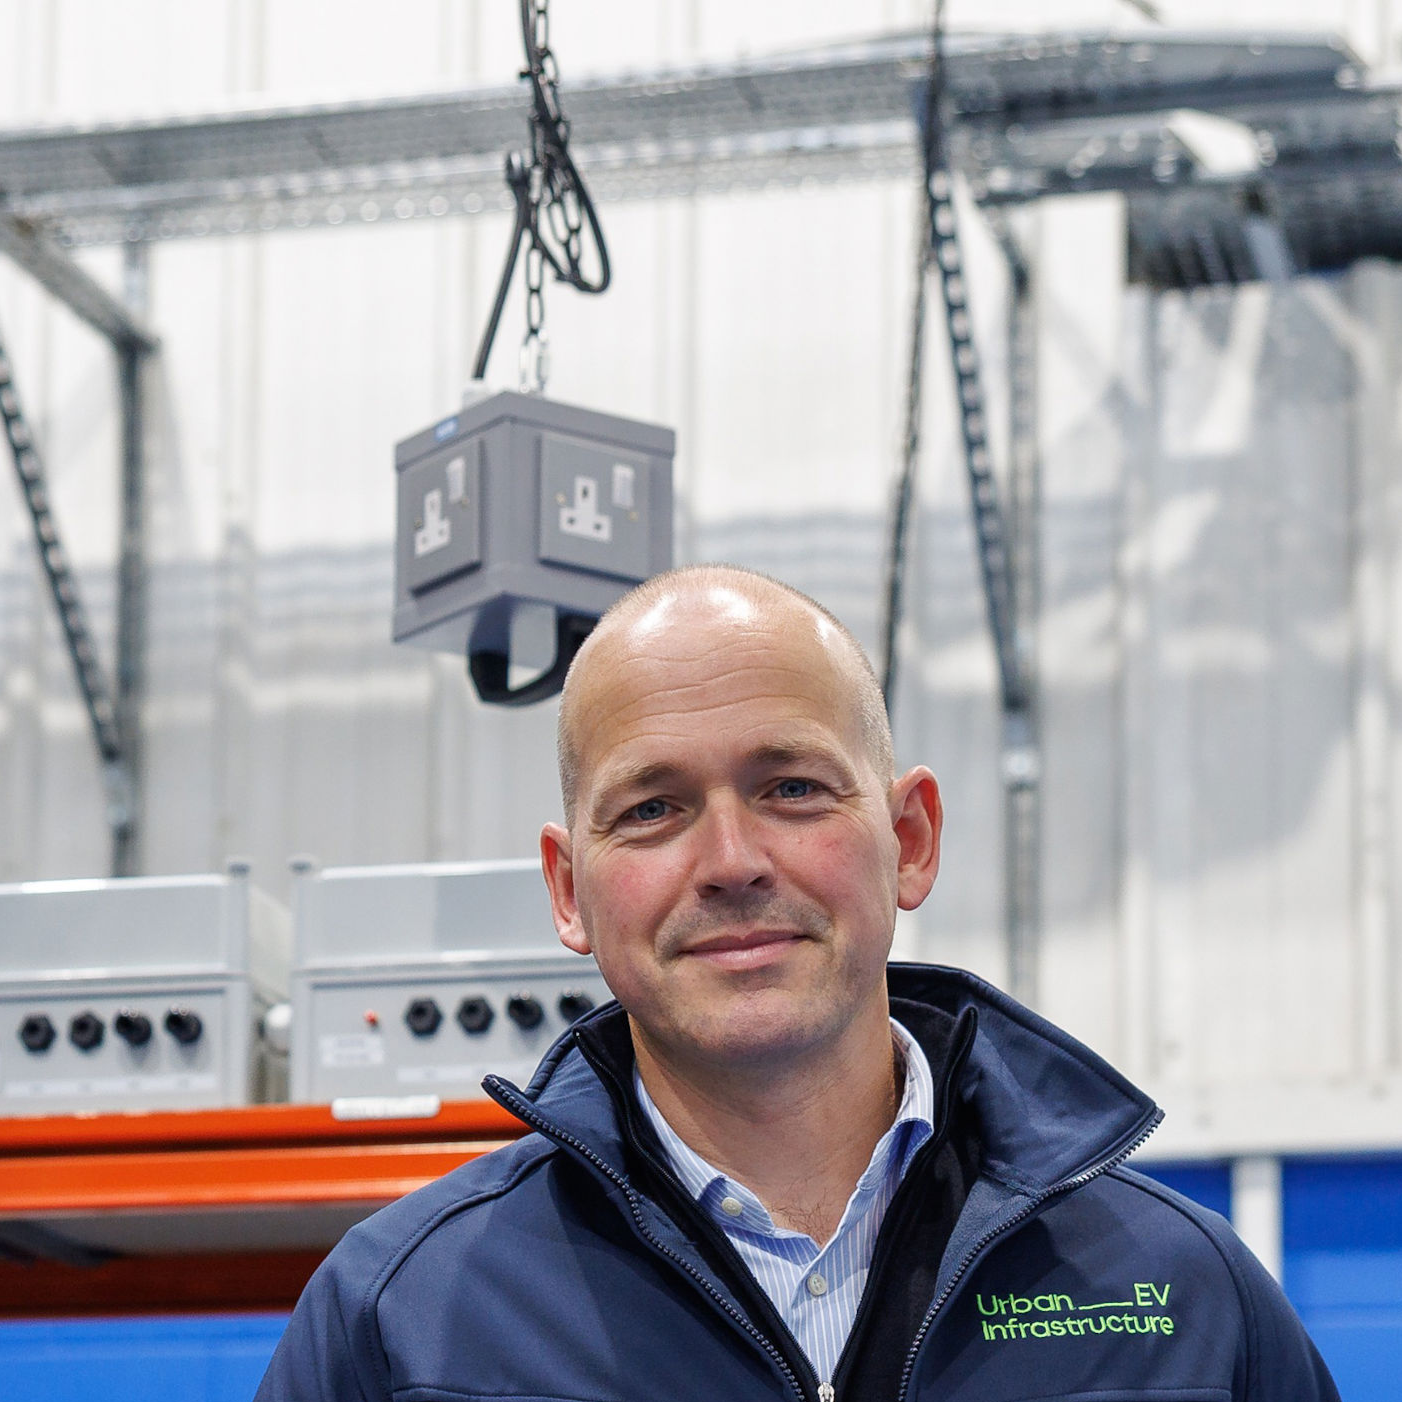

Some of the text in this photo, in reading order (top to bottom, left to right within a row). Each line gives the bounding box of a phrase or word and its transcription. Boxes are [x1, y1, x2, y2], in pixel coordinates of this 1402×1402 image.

[976, 1282, 1171, 1316] Urban EV
[981, 1313, 1175, 1341] Infrastructure
